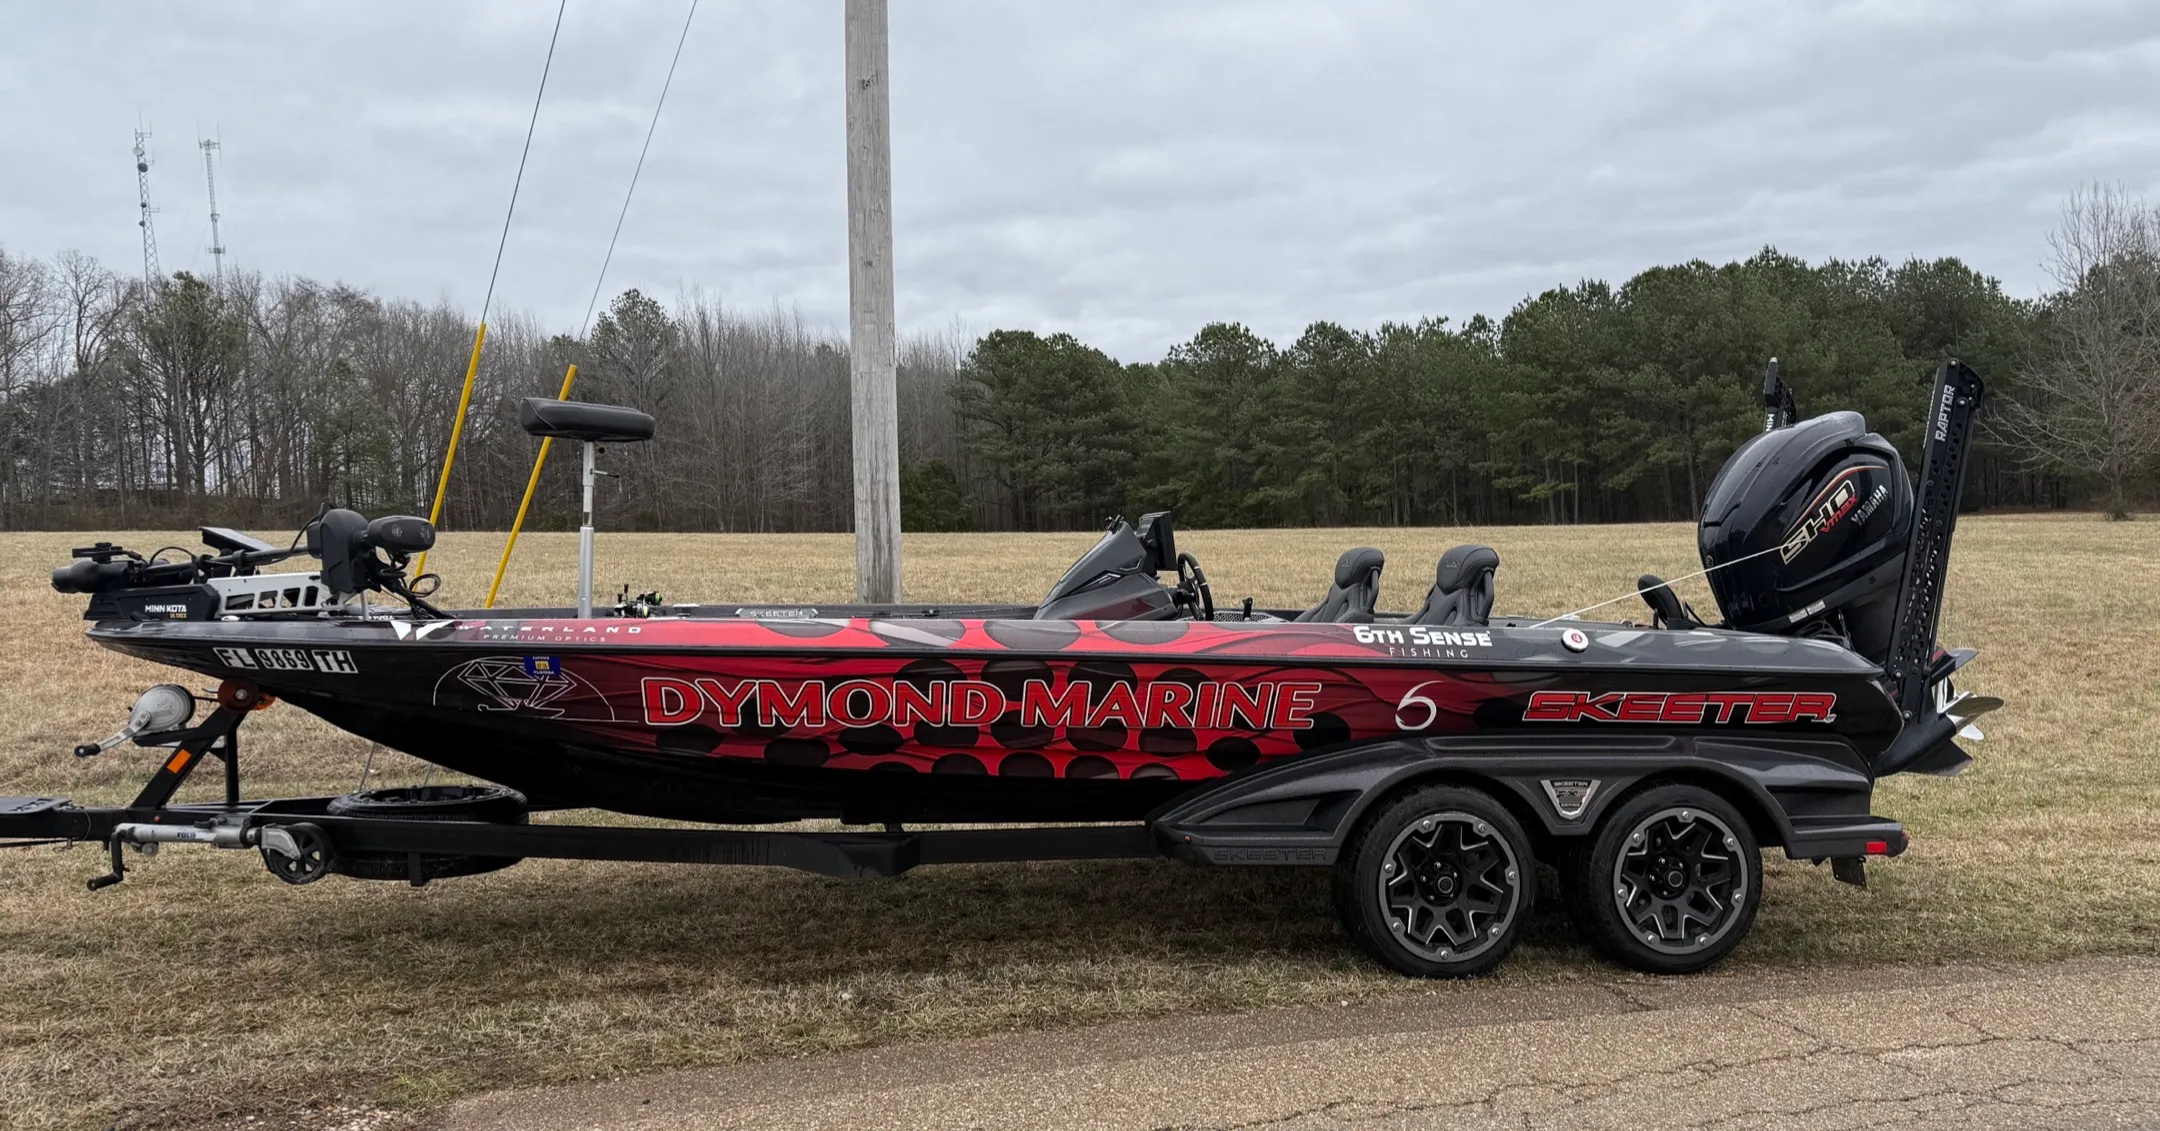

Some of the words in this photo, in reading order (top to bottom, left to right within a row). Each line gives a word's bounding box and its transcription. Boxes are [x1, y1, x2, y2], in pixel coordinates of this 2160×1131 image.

[1765, 413, 1775, 432] MIN
[1935, 384, 1955, 442] RAPTOR
[1851, 484, 1889, 526] YAMAHA
[1780, 480, 1855, 566] SHO
[145, 604, 165, 613] MINN
[166, 604, 187, 613] KOTA
[458, 625, 642, 634] WATERLAND
[1409, 627, 1492, 647] SENSE
[215, 648, 256, 668] FL
[257, 650, 310, 669] 9869
[313, 651, 356, 672] TH
[1390, 647, 1468, 658] FISHING
[641, 677, 1006, 727] DYMOND
[1021, 679, 1322, 729] MARINE
[1522, 691, 1836, 724] SKEETER
[1214, 848, 1327, 861] SKEETER
